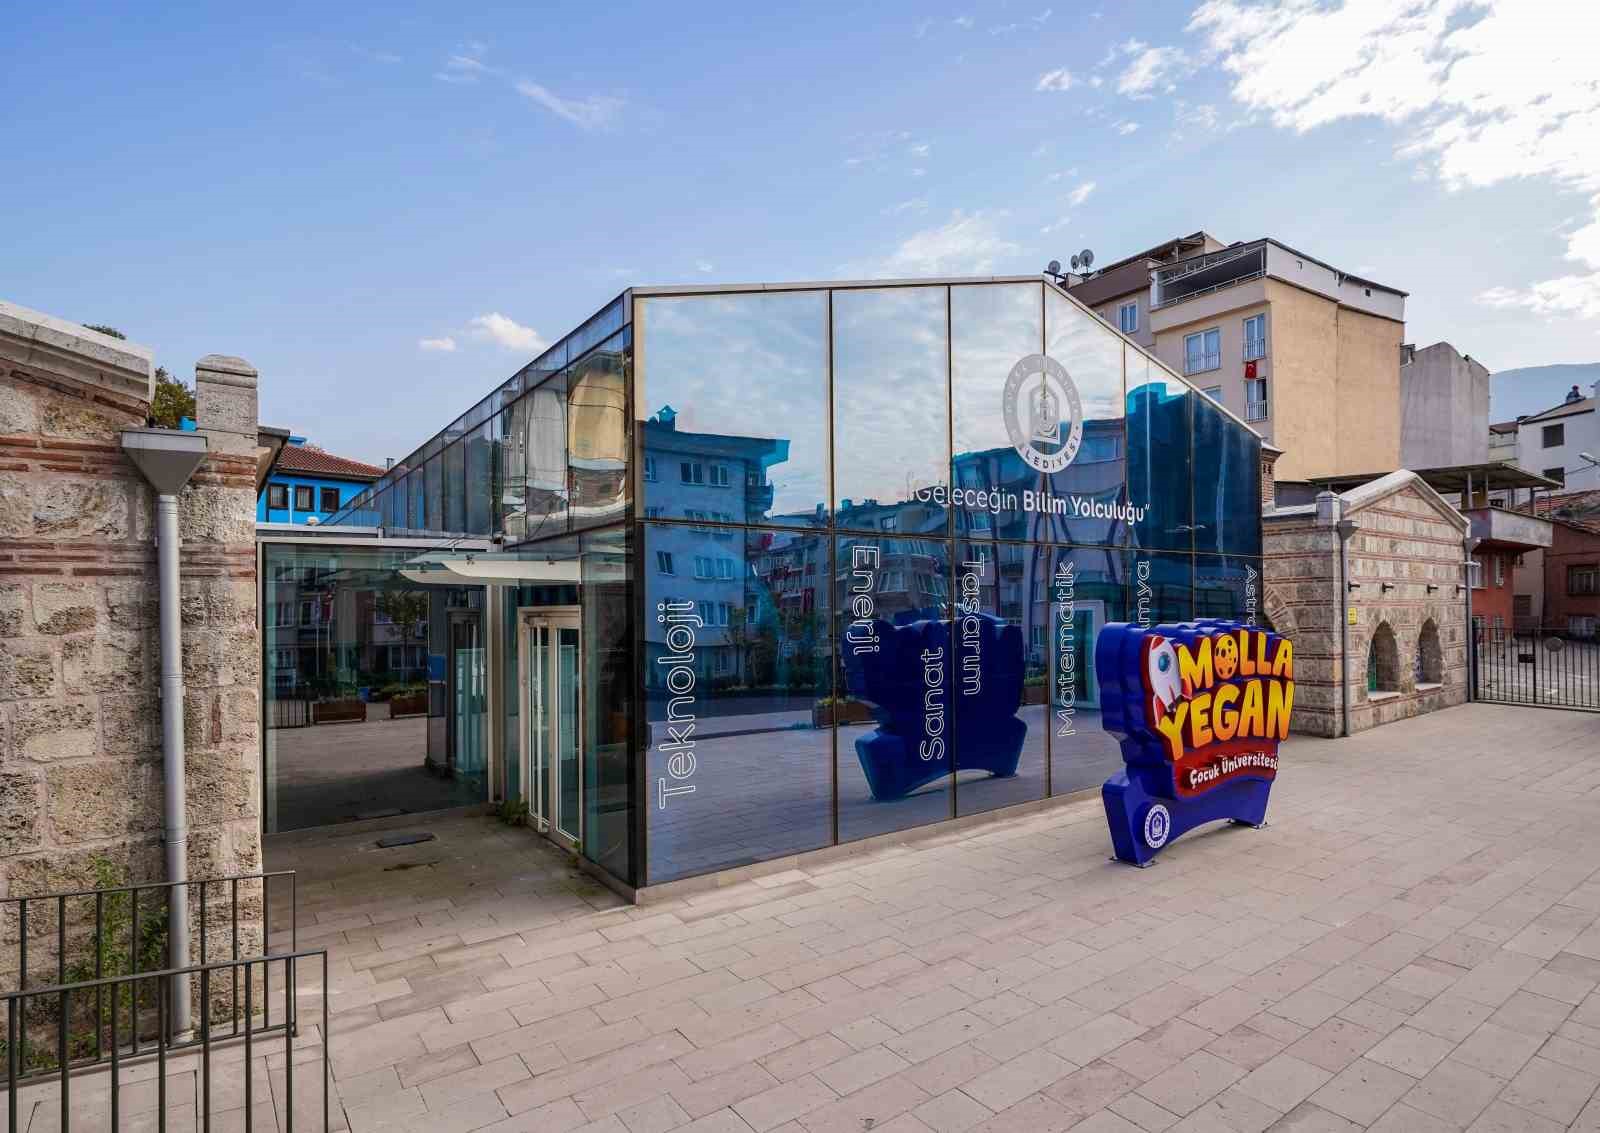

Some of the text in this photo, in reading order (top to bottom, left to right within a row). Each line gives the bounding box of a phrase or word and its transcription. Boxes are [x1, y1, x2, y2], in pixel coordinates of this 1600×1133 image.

[1023, 490, 1066, 515] Bilim
[847, 545, 880, 655] Enerji
[962, 552, 985, 696] Tasarım
[1137, 560, 1153, 628] mya
[1055, 560, 1077, 737] Matematik
[1177, 629, 1294, 689] MOLLA
[657, 600, 703, 809] Teknoloji
[920, 647, 945, 761] Sanat
[1158, 678, 1296, 761] YEGAN
[1189, 752, 1279, 789] Çocuk Üniversitesi
